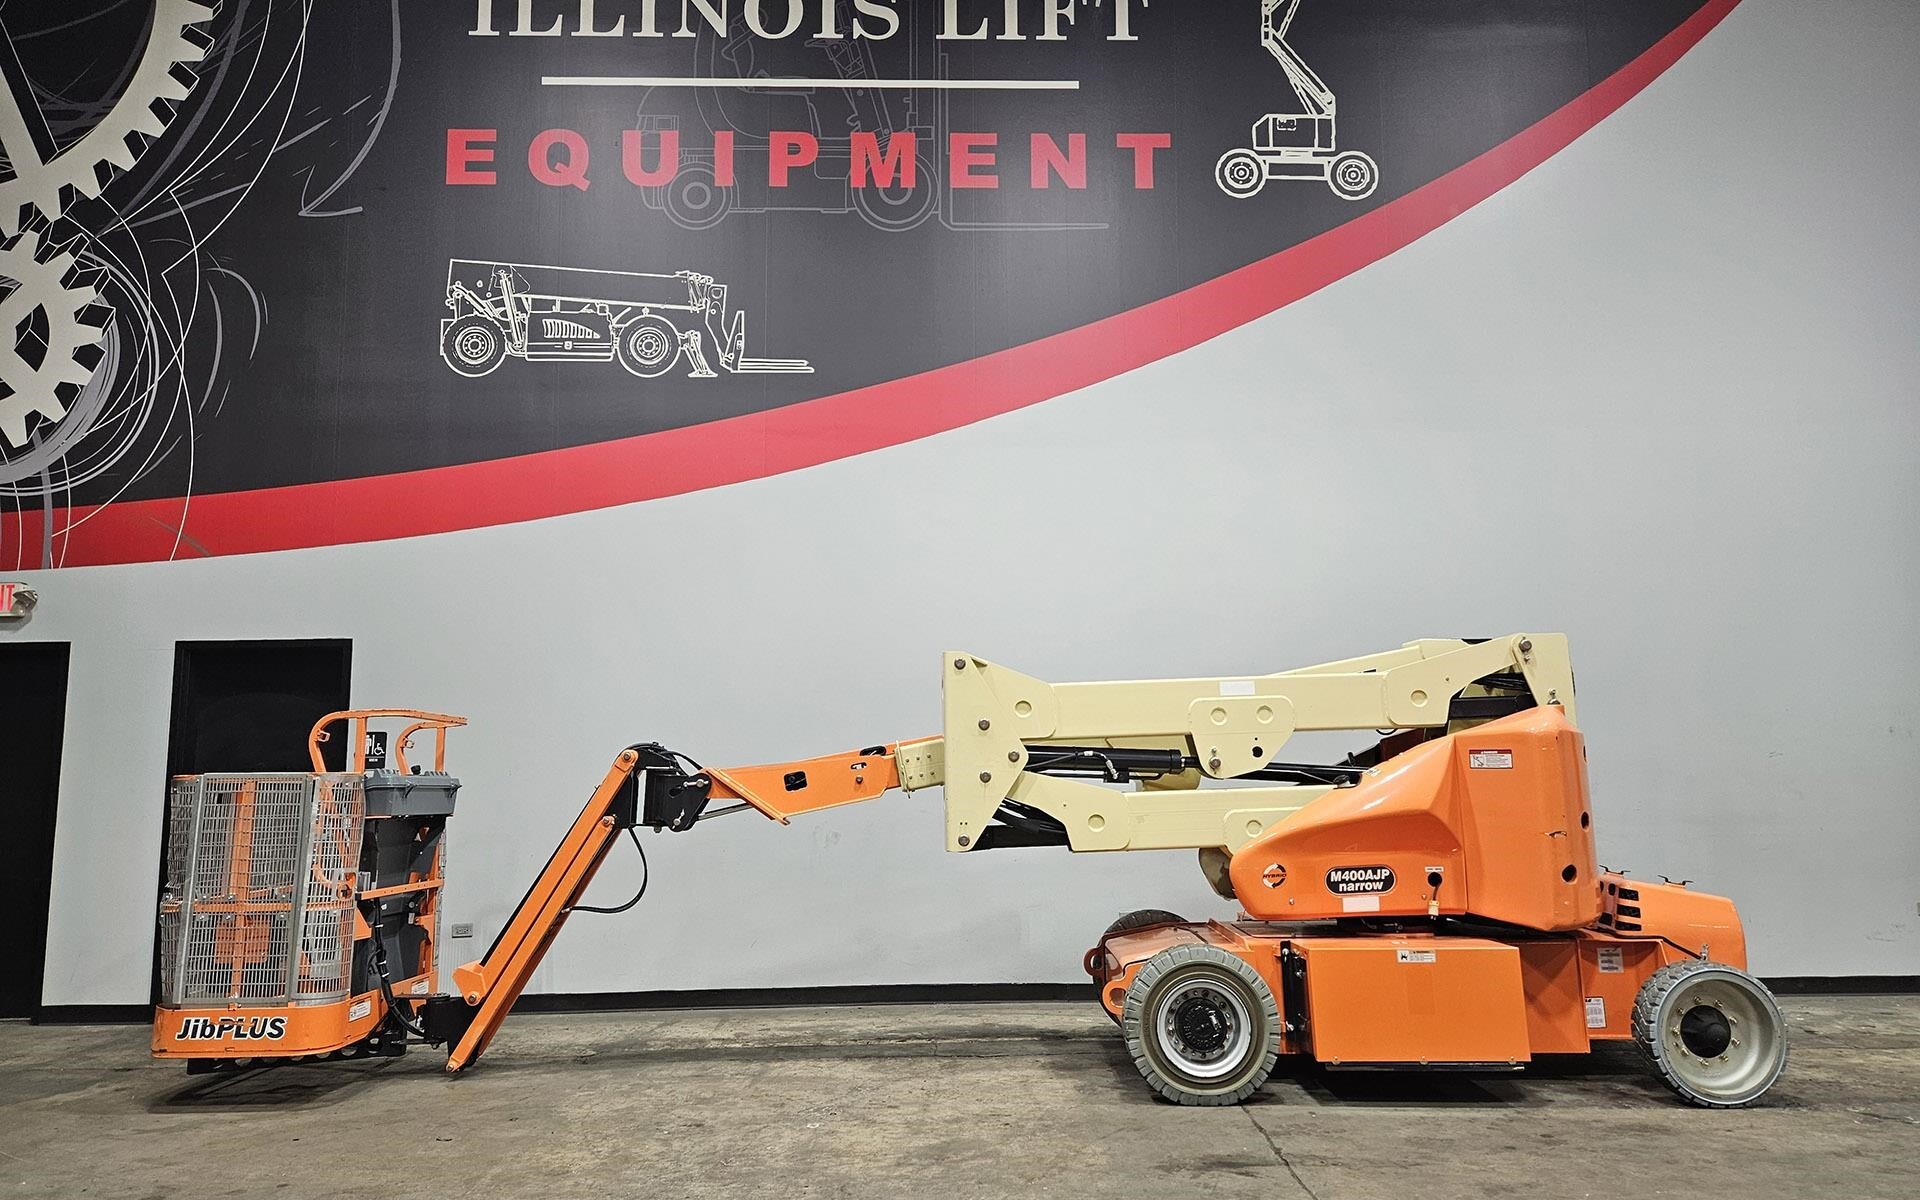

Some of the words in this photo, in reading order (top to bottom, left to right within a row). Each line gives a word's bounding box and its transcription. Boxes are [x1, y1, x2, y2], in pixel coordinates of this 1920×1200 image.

[468, 0, 899, 39] ILLINOIS
[936, 0, 1149, 40] LIFT
[446, 128, 1171, 191] EQUIPMENT
[1330, 868, 1390, 882] M400AJP
[1338, 881, 1384, 892] narrow
[176, 1016, 288, 1040] JibPLUS
